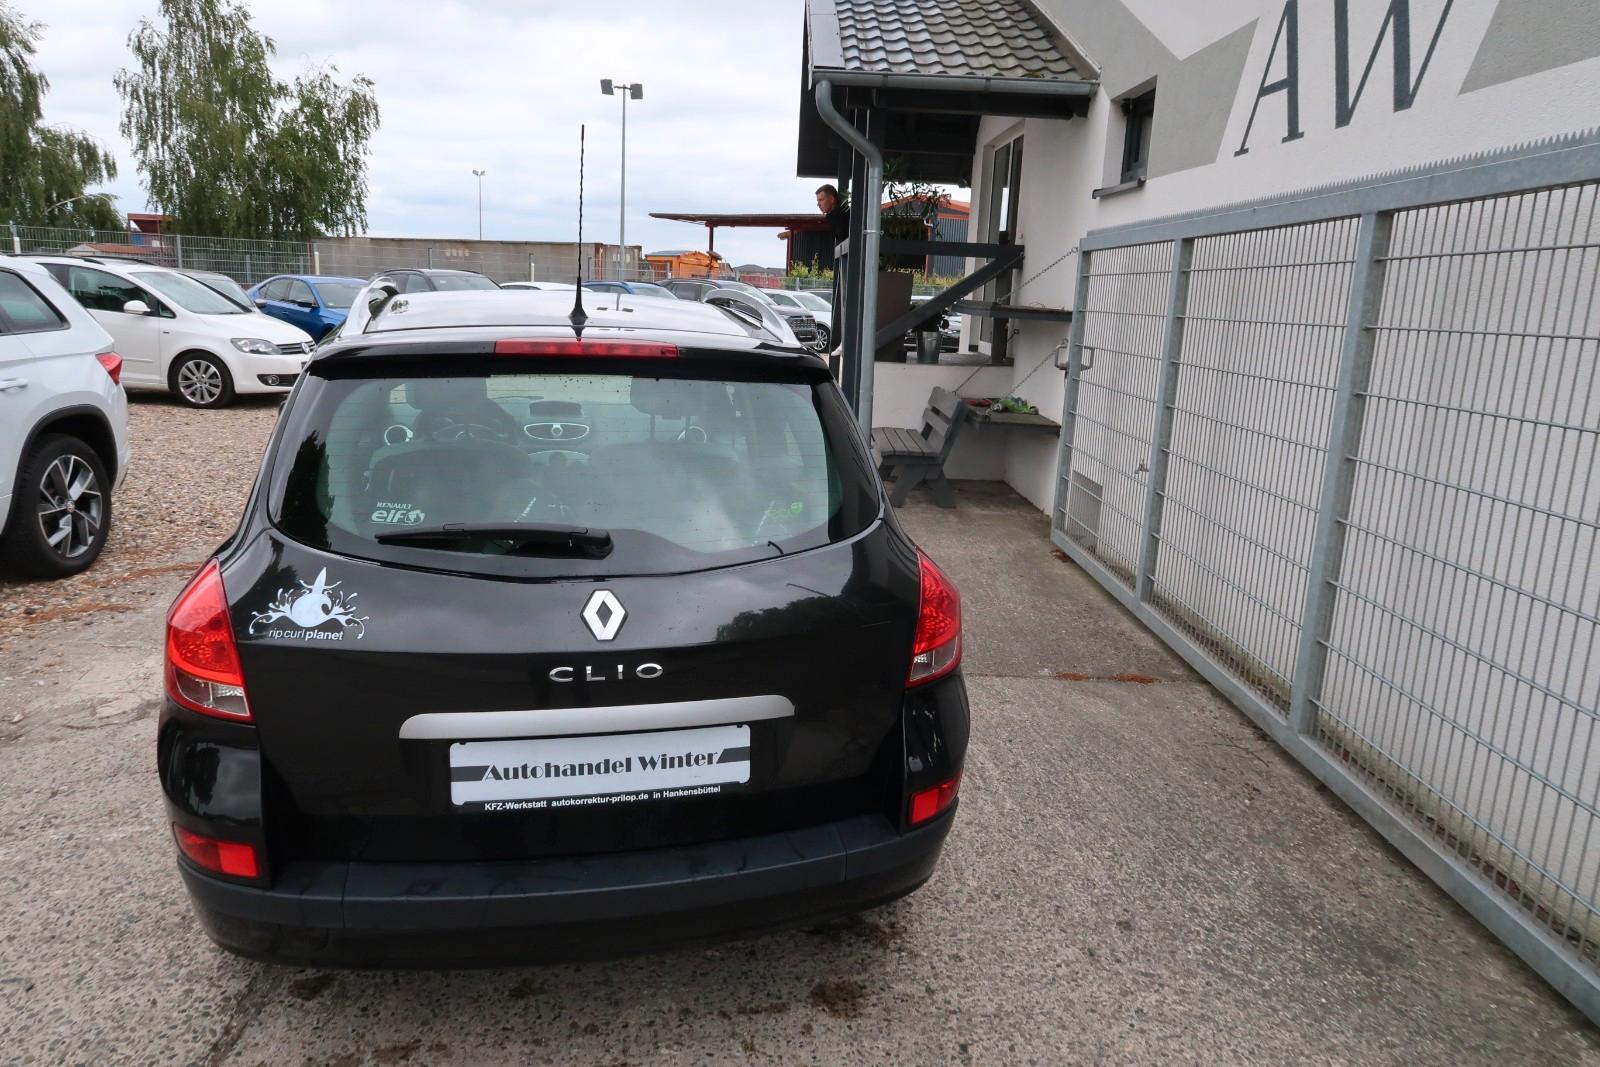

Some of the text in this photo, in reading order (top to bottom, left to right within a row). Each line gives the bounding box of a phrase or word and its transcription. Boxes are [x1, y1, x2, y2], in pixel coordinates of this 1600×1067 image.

[1234, 0, 1452, 157] AW
[376, 501, 412, 510] RENAULT
[268, 628, 344, 641] rip curl planet
[549, 663, 663, 682] CLIO
[481, 751, 719, 783] Autohandel Winter
[484, 785, 721, 811] KFZ-Werkstatt autokorrektur-prilop.de in Hankensbüttel
